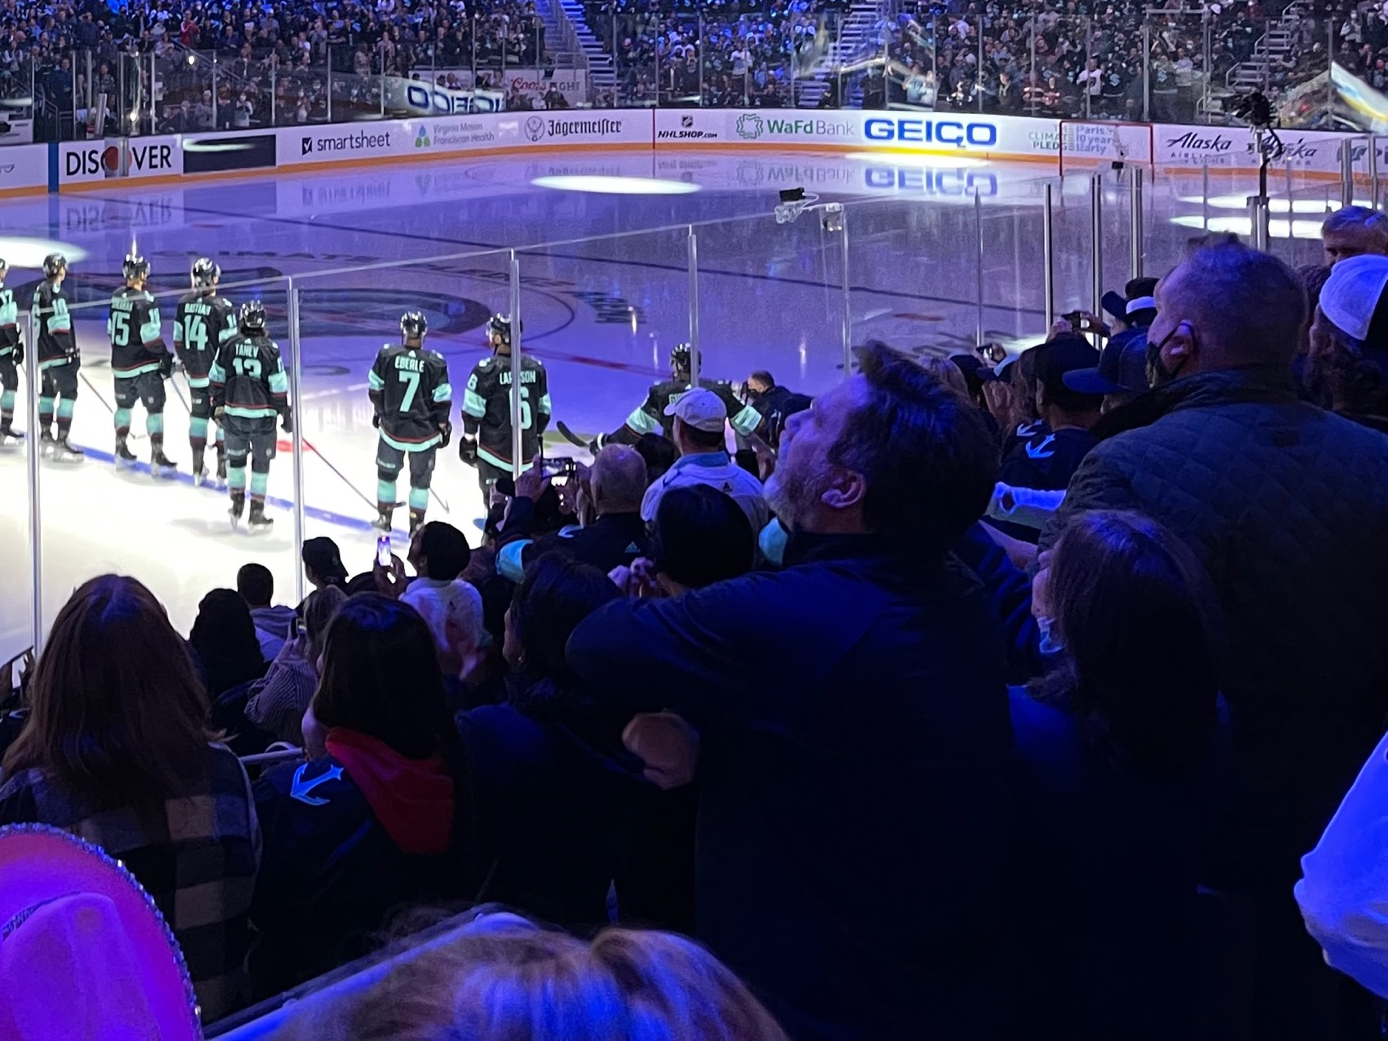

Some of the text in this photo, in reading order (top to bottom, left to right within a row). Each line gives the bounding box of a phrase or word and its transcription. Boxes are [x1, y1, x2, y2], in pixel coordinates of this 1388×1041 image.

[767, 120, 856, 135] WaFd Bank
[864, 118, 997, 146] GEICO
[317, 130, 390, 151] smartsheet
[1167, 132, 1232, 150] Alaska
[184, 315, 208, 351] 14
[235, 343, 259, 359] TANEV
[395, 356, 424, 373] EBERLE
[399, 372, 420, 413] 7
